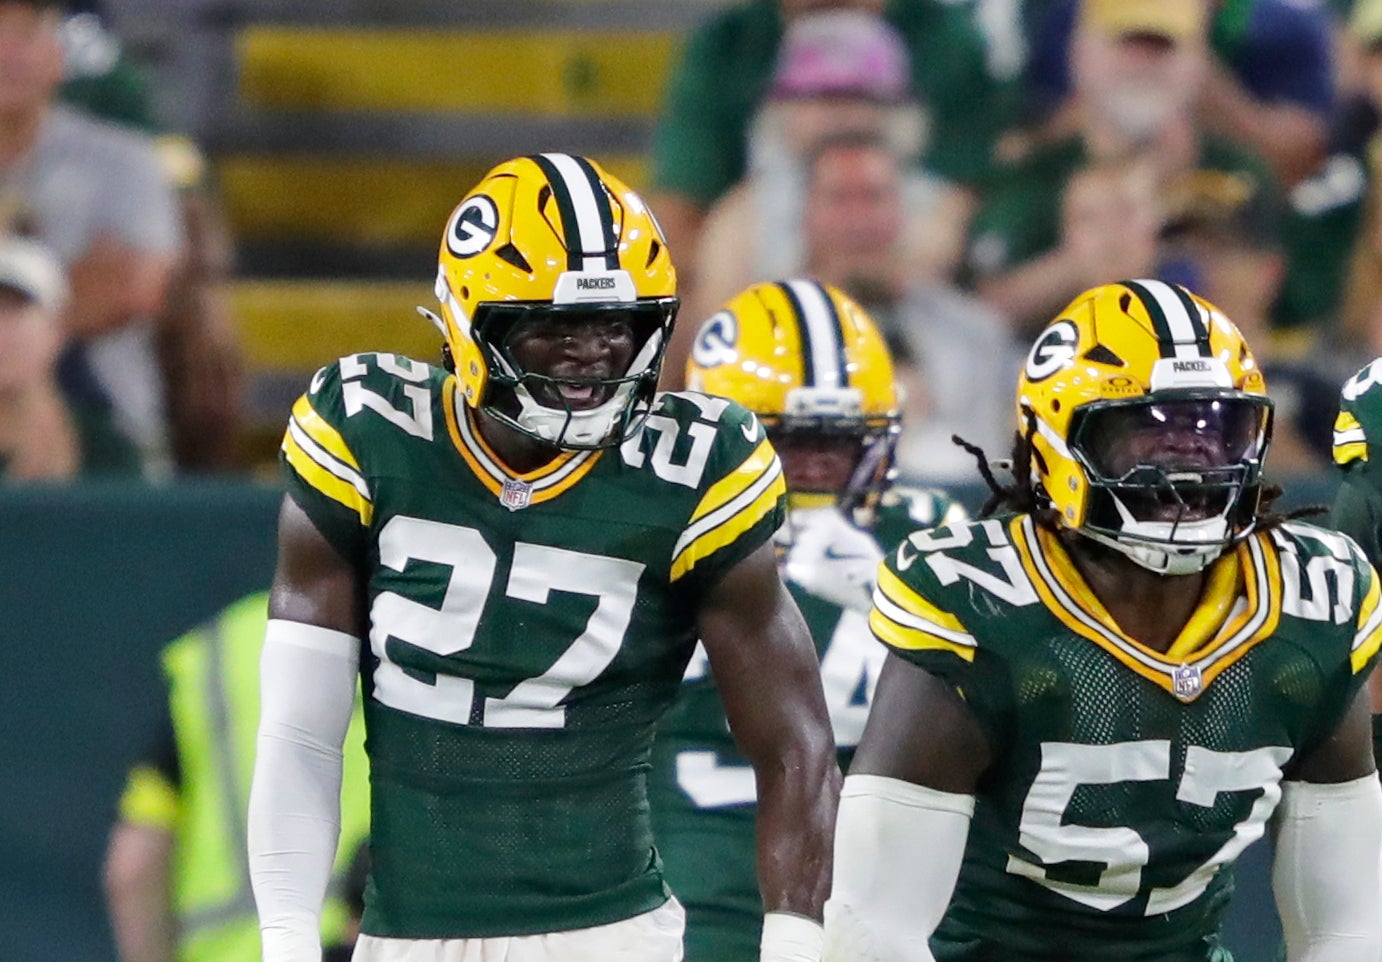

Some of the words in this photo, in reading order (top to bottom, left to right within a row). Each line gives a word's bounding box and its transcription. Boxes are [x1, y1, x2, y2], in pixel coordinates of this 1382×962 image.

[577, 278, 615, 290] PACKERS
[370, 514, 647, 730] 27
[1005, 739, 1295, 918] 57
